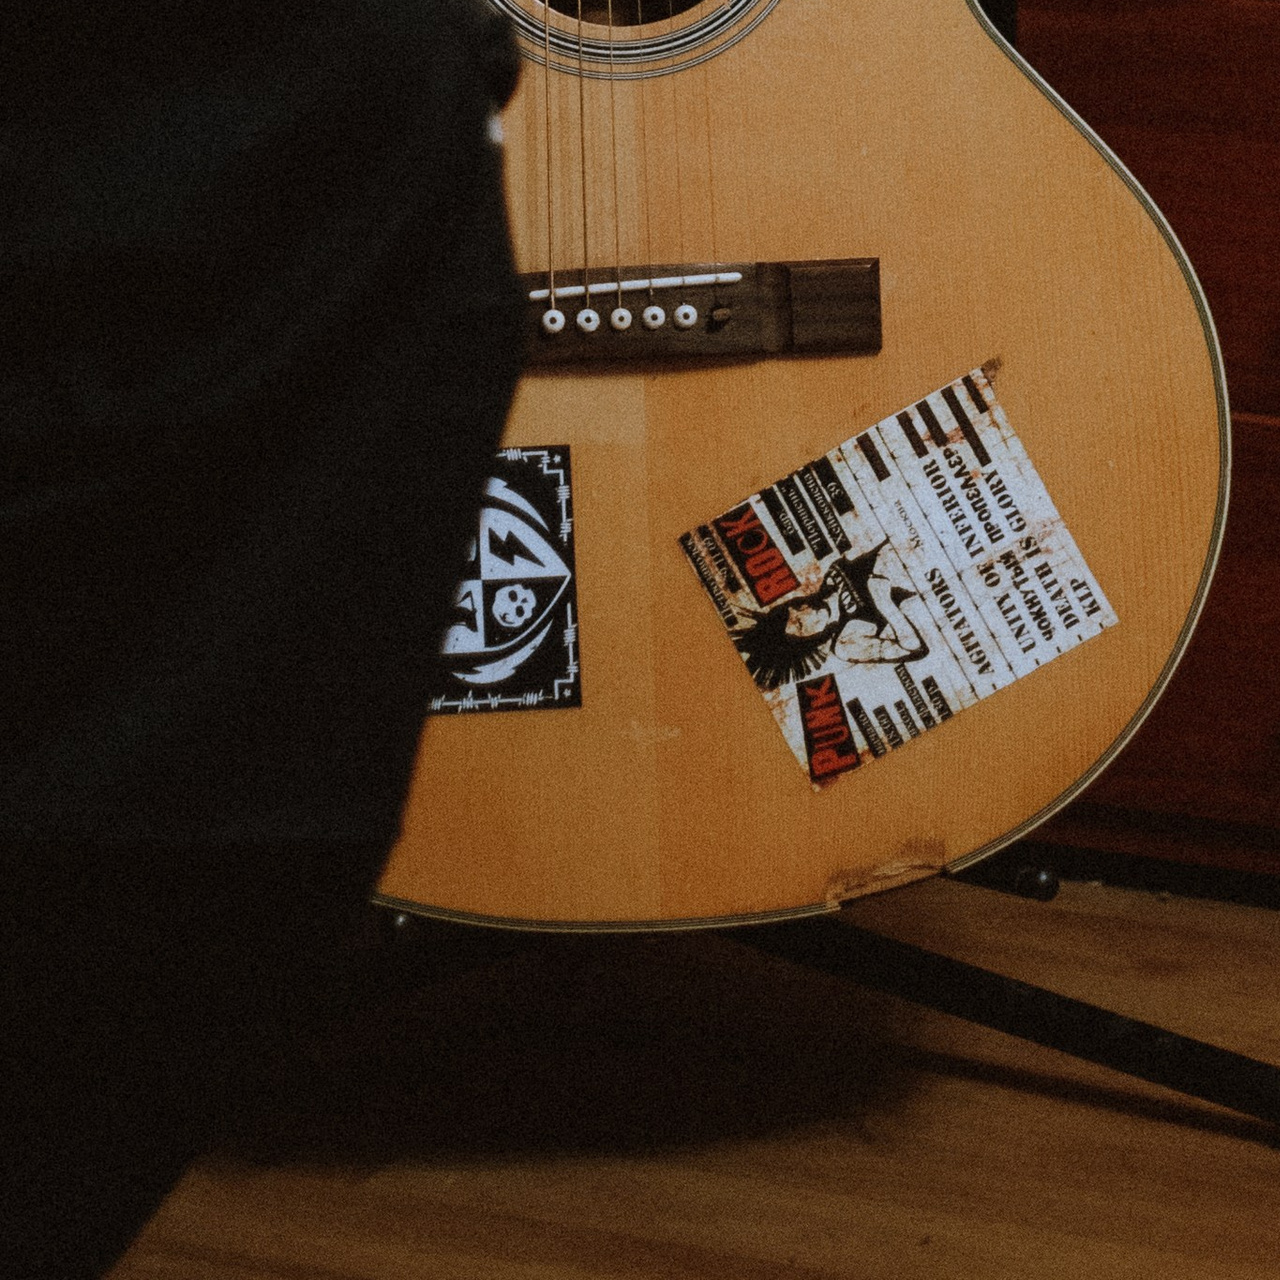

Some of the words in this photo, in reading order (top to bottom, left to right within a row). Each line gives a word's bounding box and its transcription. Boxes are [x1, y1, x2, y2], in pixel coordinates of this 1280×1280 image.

[825, 479, 844, 500] 39
[919, 457, 987, 558] INFERIOR
[980, 465, 1029, 534] GLORY
[717, 503, 798, 604] ROCK
[974, 557, 1003, 590] OF
[1017, 532, 1042, 559] IS
[922, 565, 996, 679] AGITATORS
[991, 588, 1038, 654] UNITY
[1032, 560, 1082, 630] DEATH
[1067, 573, 1102, 617] KLP
[802, 675, 858, 777] PUNK
